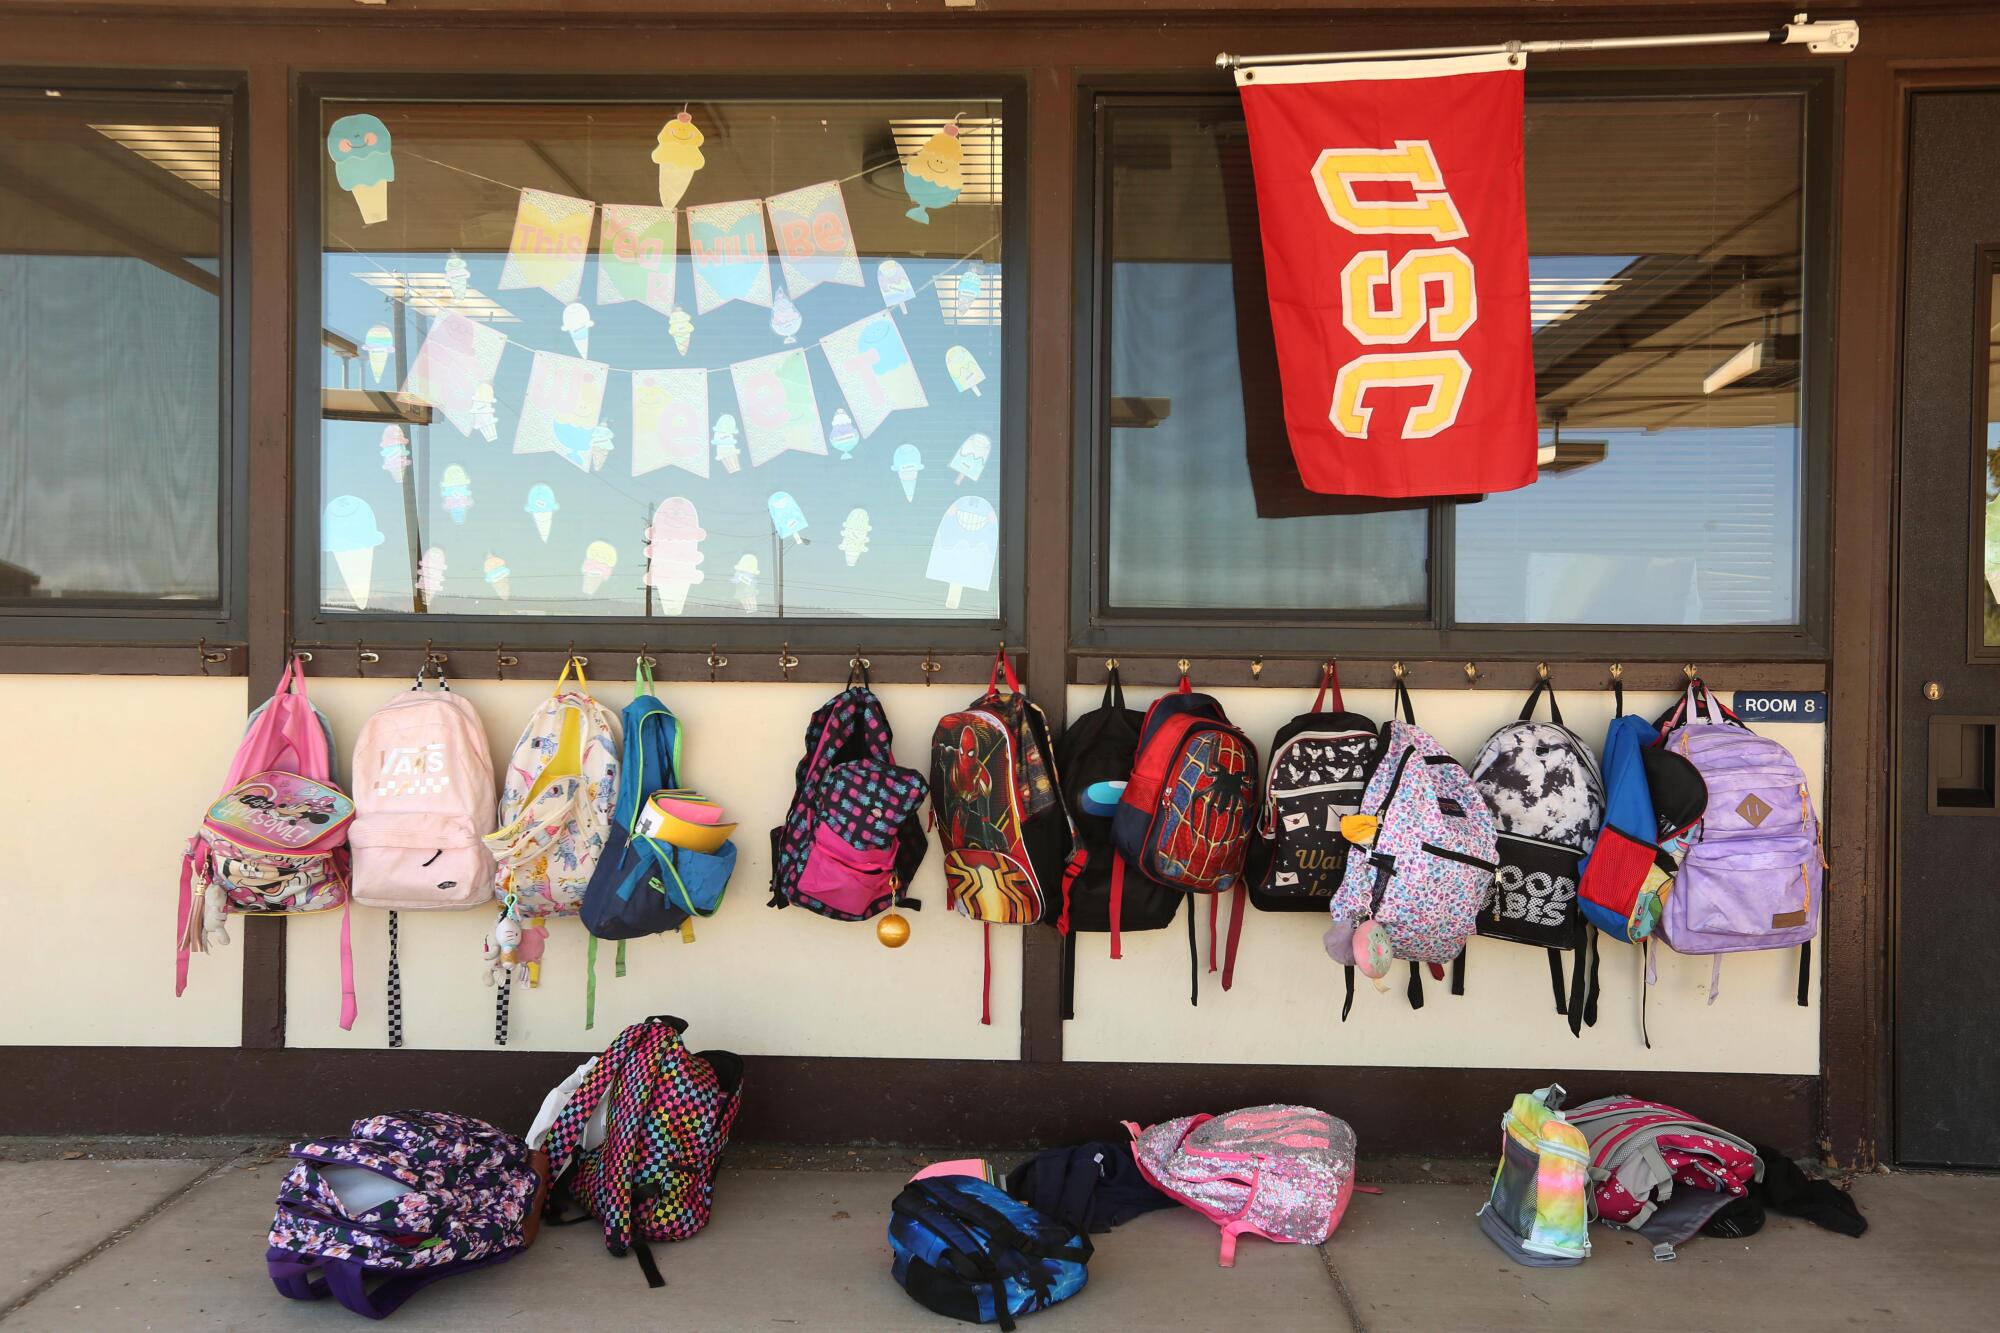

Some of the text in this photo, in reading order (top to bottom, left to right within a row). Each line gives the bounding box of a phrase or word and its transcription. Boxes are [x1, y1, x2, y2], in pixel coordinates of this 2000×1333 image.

[517, 222, 584, 262] This
[780, 211, 847, 262] Be
[1311, 139, 1478, 440] USC
[1744, 699, 1816, 713] ROOM 8
[1494, 865, 1576, 903] OOD
